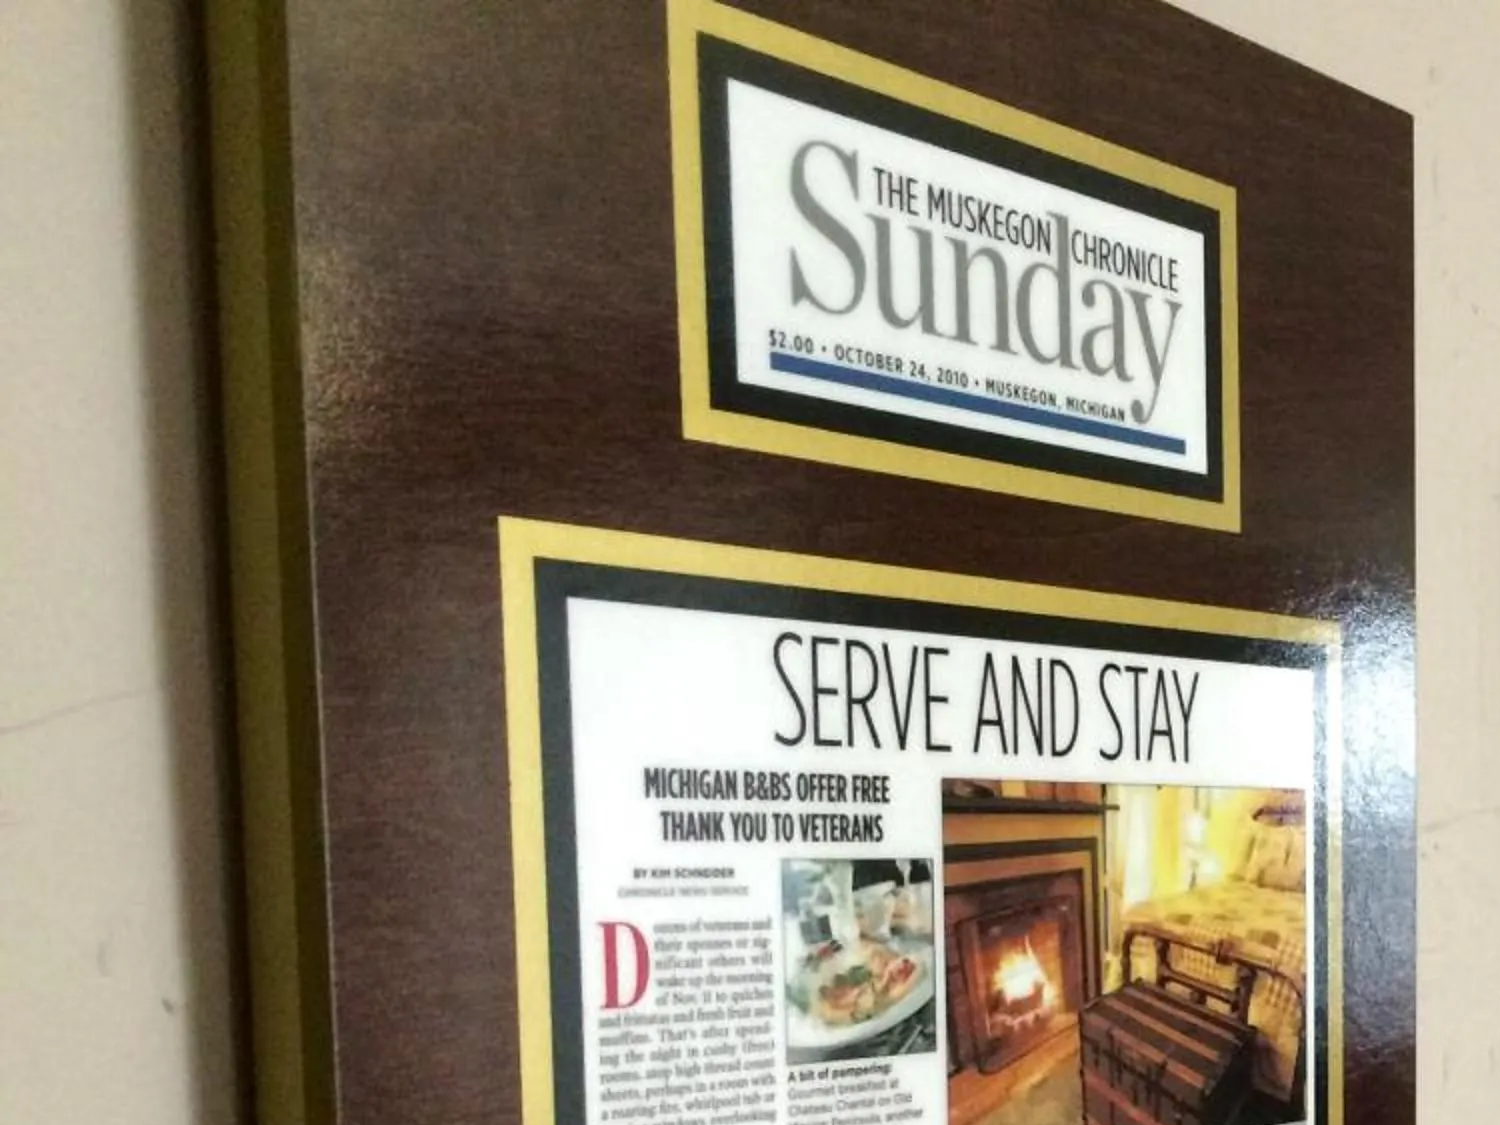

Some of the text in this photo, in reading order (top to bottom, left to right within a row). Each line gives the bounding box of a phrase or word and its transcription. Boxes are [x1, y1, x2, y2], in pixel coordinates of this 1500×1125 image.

[873, 166, 1180, 293] THE MUSKEGON CHRONICLE
[790, 140, 1183, 425] Sunday
[768, 329, 1127, 424] $2.00 OCTOBER 24, 2010 MUSKEGON, MICHIGAN
[773, 631, 1199, 764] SERVE AND STAY
[643, 766, 891, 805] MICHIGAN B&BS OFFER FREE
[660, 809, 885, 843] THANK YOU TO VETERANS
[634, 867, 648, 879] BY
[651, 867, 672, 879] KIM
